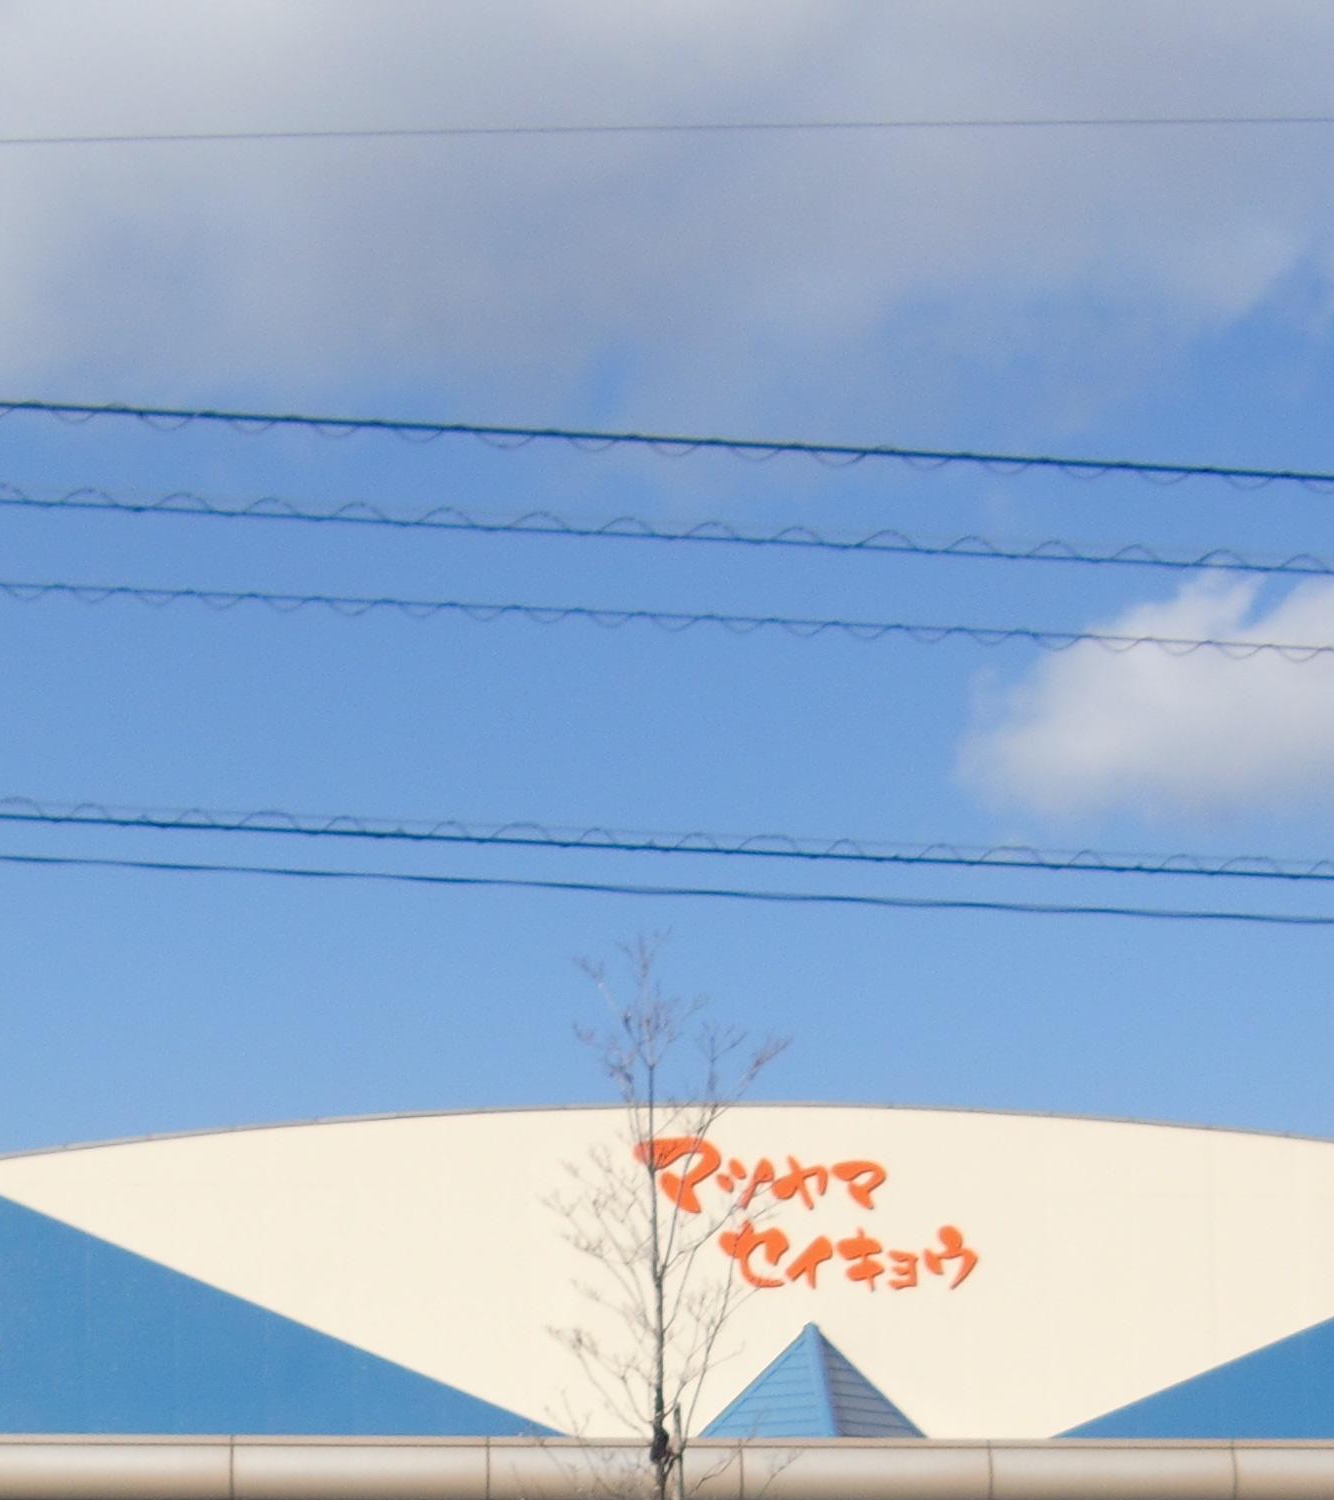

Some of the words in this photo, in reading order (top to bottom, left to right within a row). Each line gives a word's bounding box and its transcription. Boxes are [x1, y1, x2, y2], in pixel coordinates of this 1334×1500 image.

[633, 1136, 887, 1214] マツヤマ
[718, 1220, 978, 1291] セイキョウ
